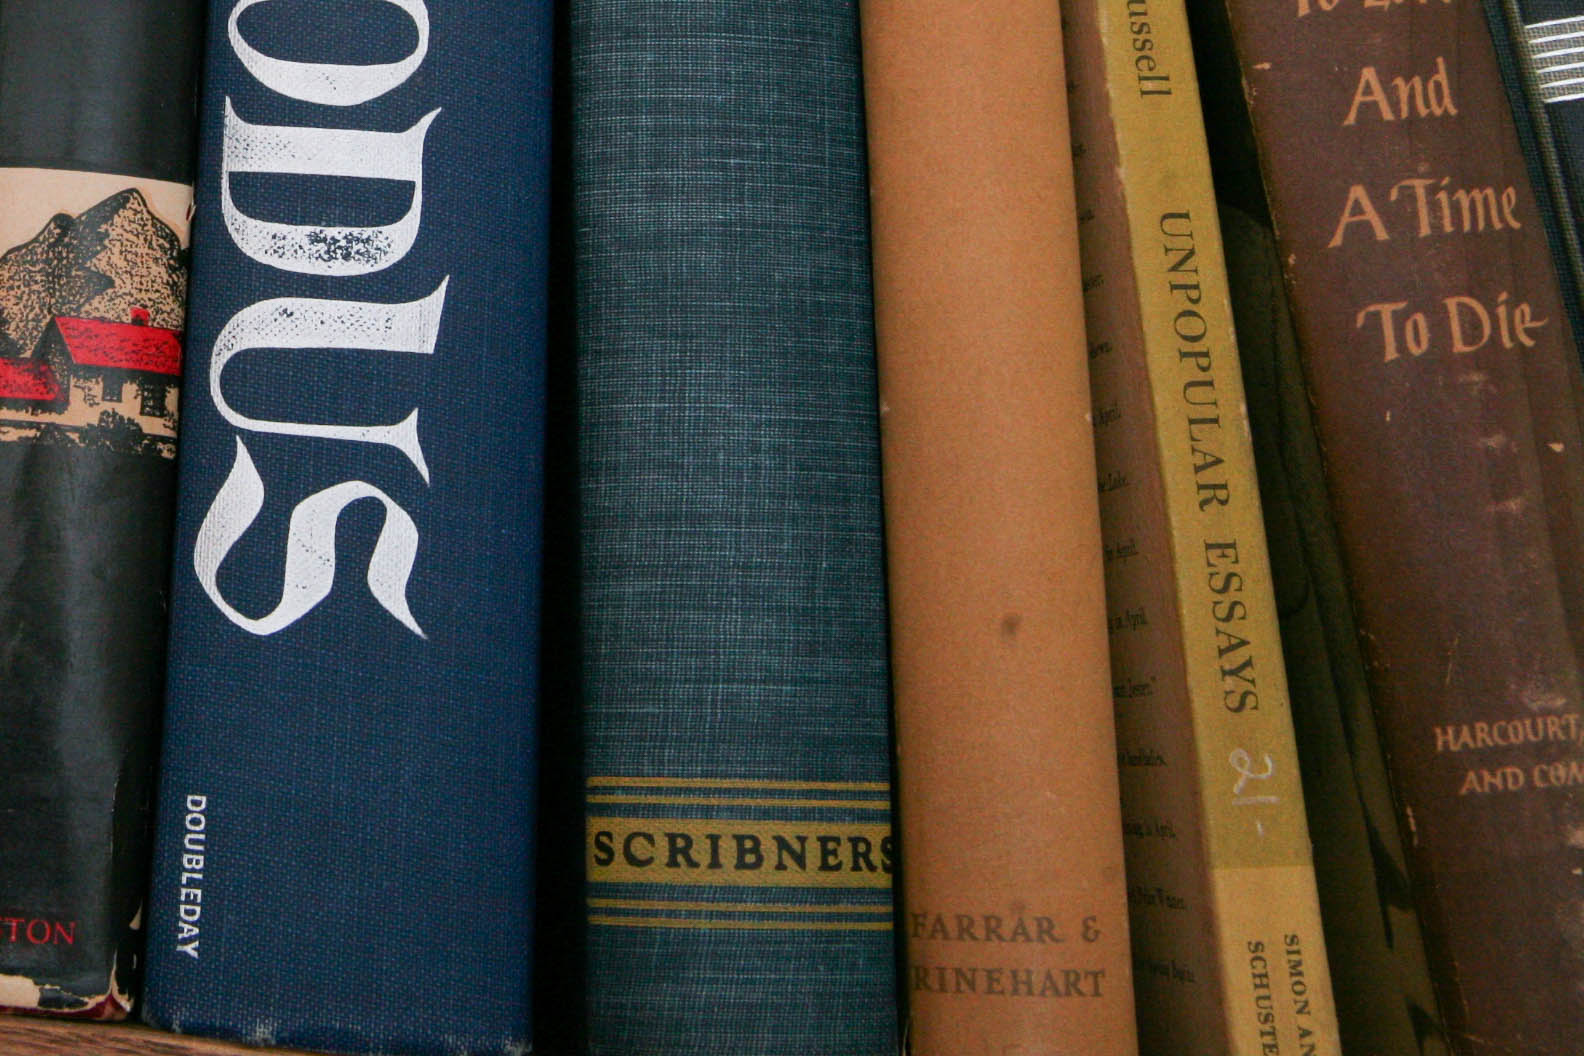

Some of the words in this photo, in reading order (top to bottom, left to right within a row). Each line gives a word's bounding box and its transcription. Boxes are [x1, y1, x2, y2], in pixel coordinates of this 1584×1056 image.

[1343, 56, 1458, 126] And
[1327, 184, 1391, 249] A
[1390, 176, 1521, 238] Time
[1356, 300, 1431, 363] To
[1442, 291, 1549, 354] Die
[1159, 209, 1231, 513] UNPOPULAR
[1203, 538, 1259, 714] ESSAYS
[1460, 765, 1525, 795] AND
[176, 794, 207, 960] DOUBLEDAY
[593, 830, 896, 875] SCRIBNERS
[911, 912, 1065, 943] FARRAR
[1081, 916, 1101, 943] &
[911, 965, 1105, 997] RINEHART
[1248, 941, 1279, 1056] SCHUSTE
[1284, 933, 1311, 1016] SIMON
[1297, 1025, 1318, 1056] AN
